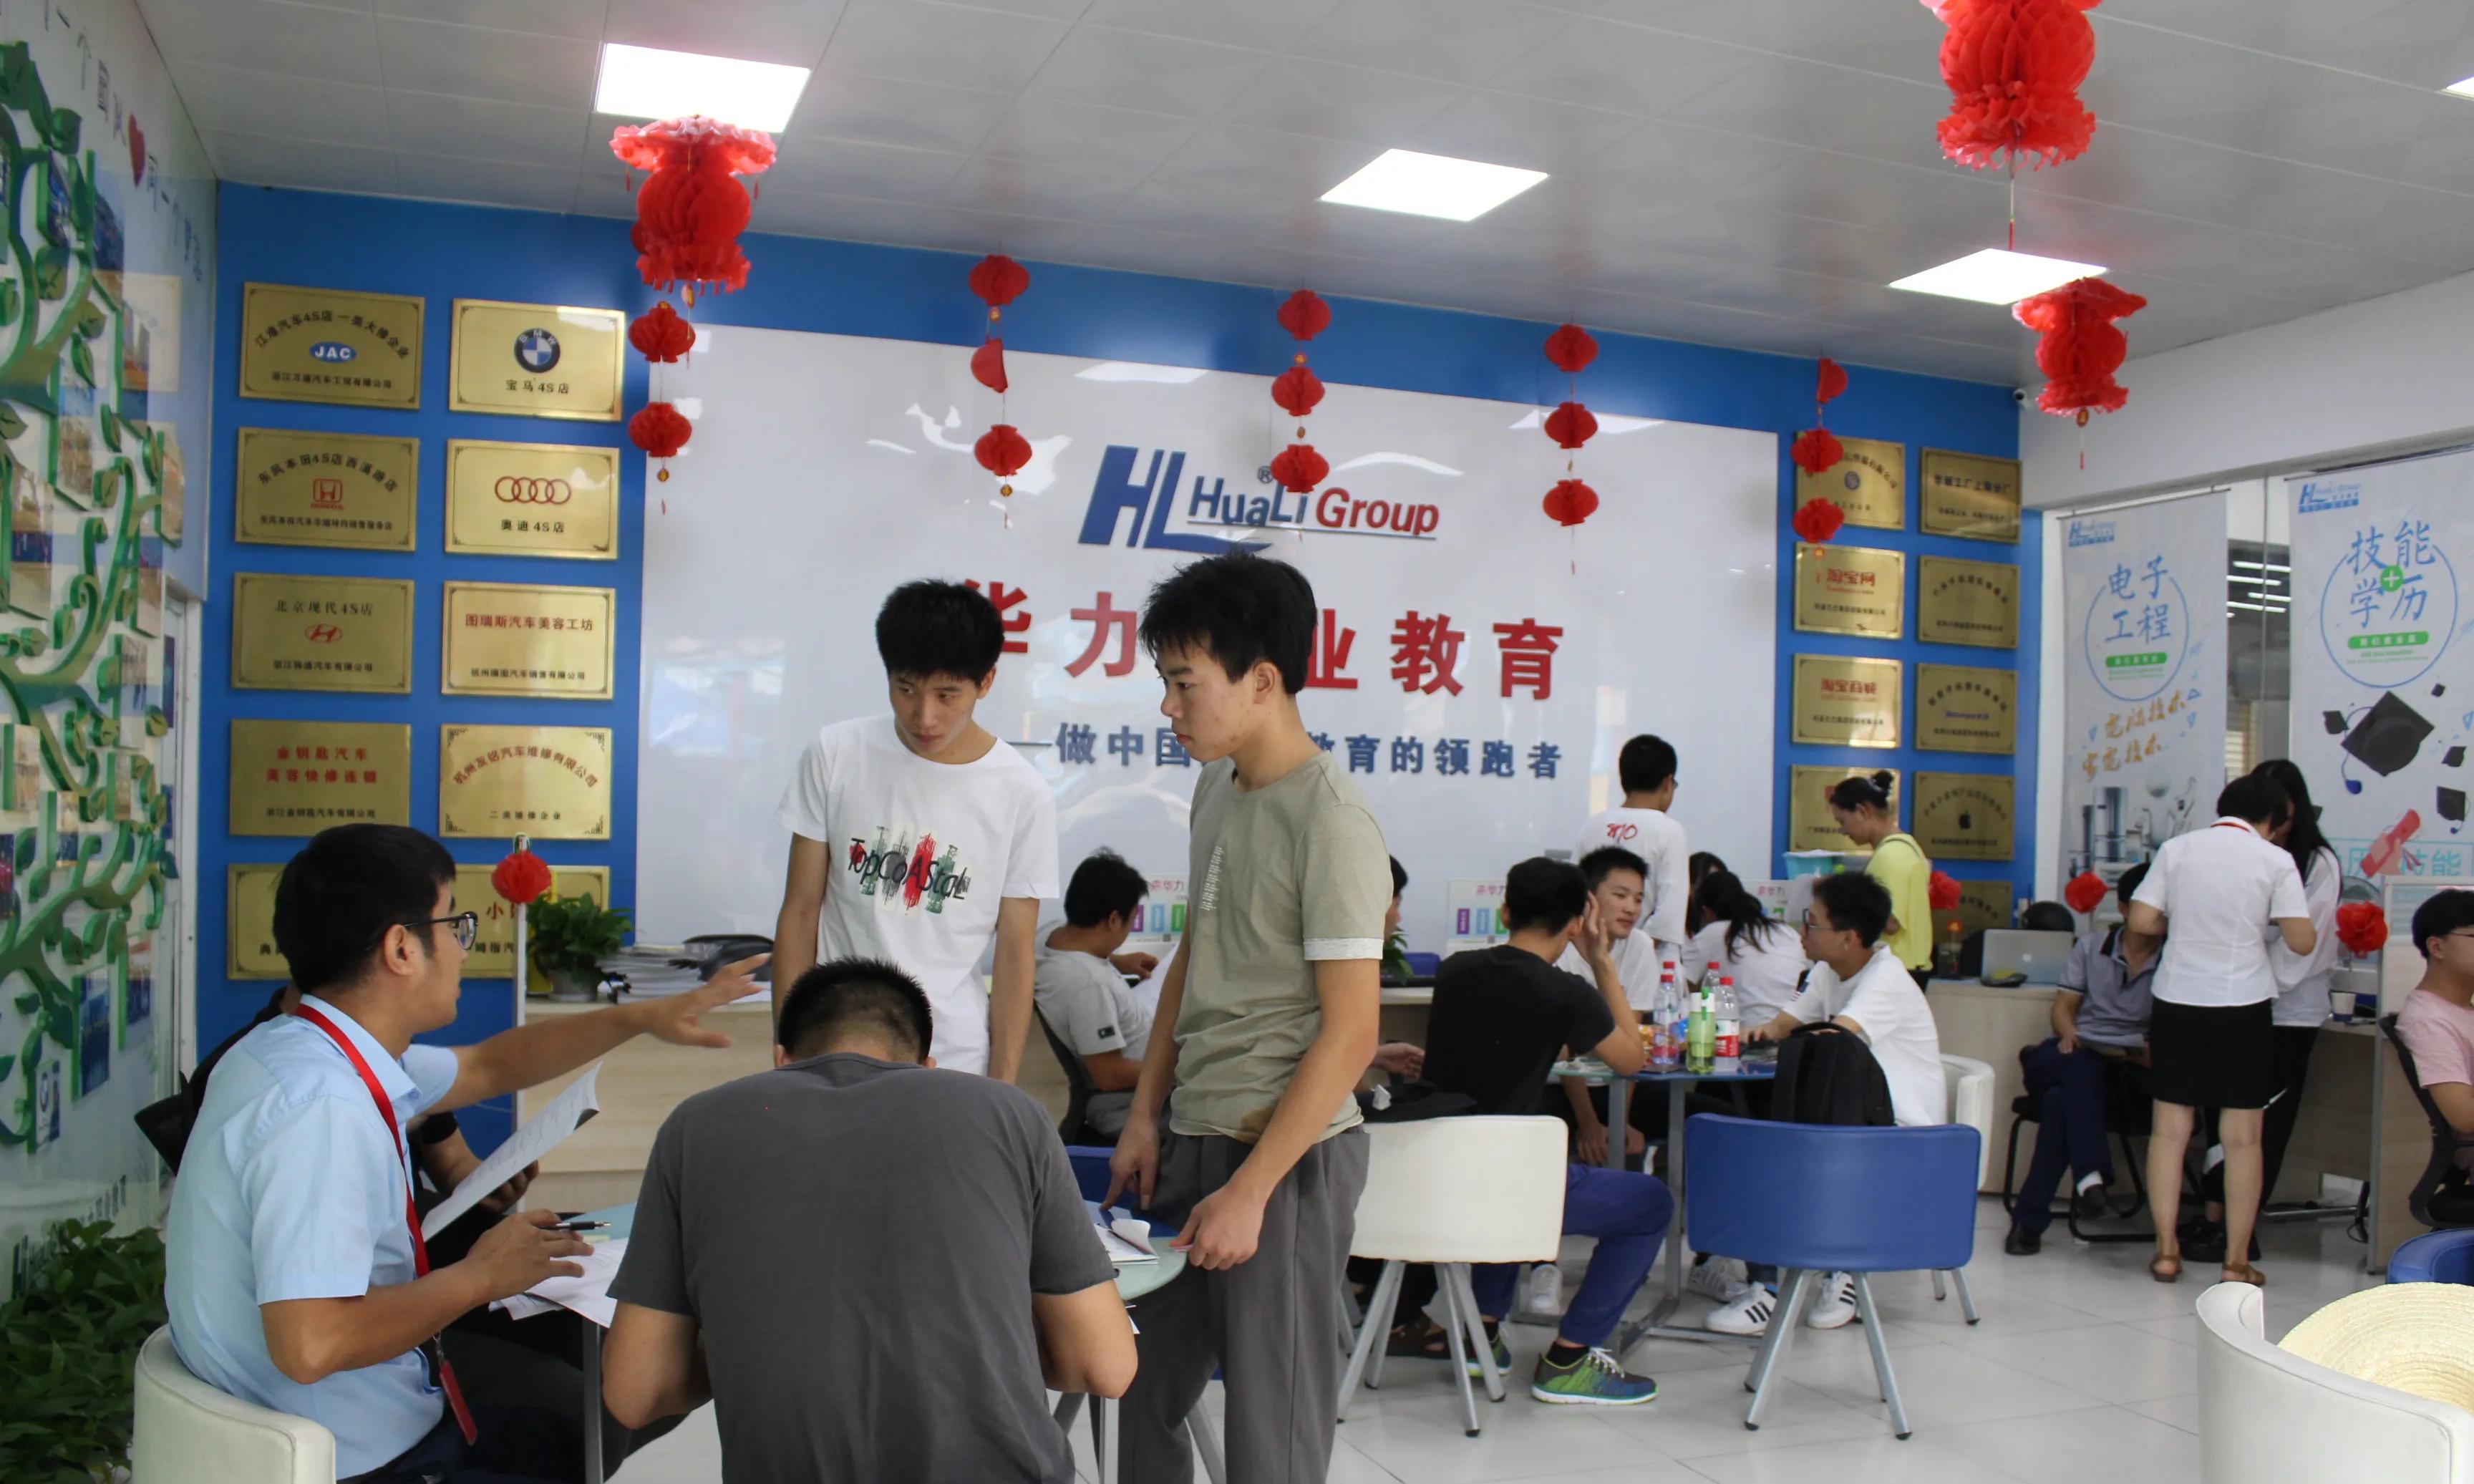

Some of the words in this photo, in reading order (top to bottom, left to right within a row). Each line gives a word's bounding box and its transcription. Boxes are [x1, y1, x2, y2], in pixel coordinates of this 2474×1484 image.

[519, 329, 557, 345] BMW
[314, 346, 352, 359] JAC
[505, 379, 569, 394] 宝马4S店
[1189, 475, 1309, 527] HuaLi
[1316, 487, 1440, 535] Group
[500, 519, 565, 534] 奥迪4S店
[2347, 520, 2435, 575] 技能
[1826, 568, 1876, 586] 淘宝网
[2108, 555, 2168, 600] 电子
[274, 598, 374, 616] 北京现代4S店
[2351, 573, 2427, 629] 学历
[465, 614, 593, 631] 图瑞斯汽车美容工坊
[2105, 603, 2171, 645] 工程
[964, 578, 1563, 700] 华力业教育
[276, 746, 369, 762] 金钥匙汽车
[266, 767, 378, 784] 美容快修连锁
